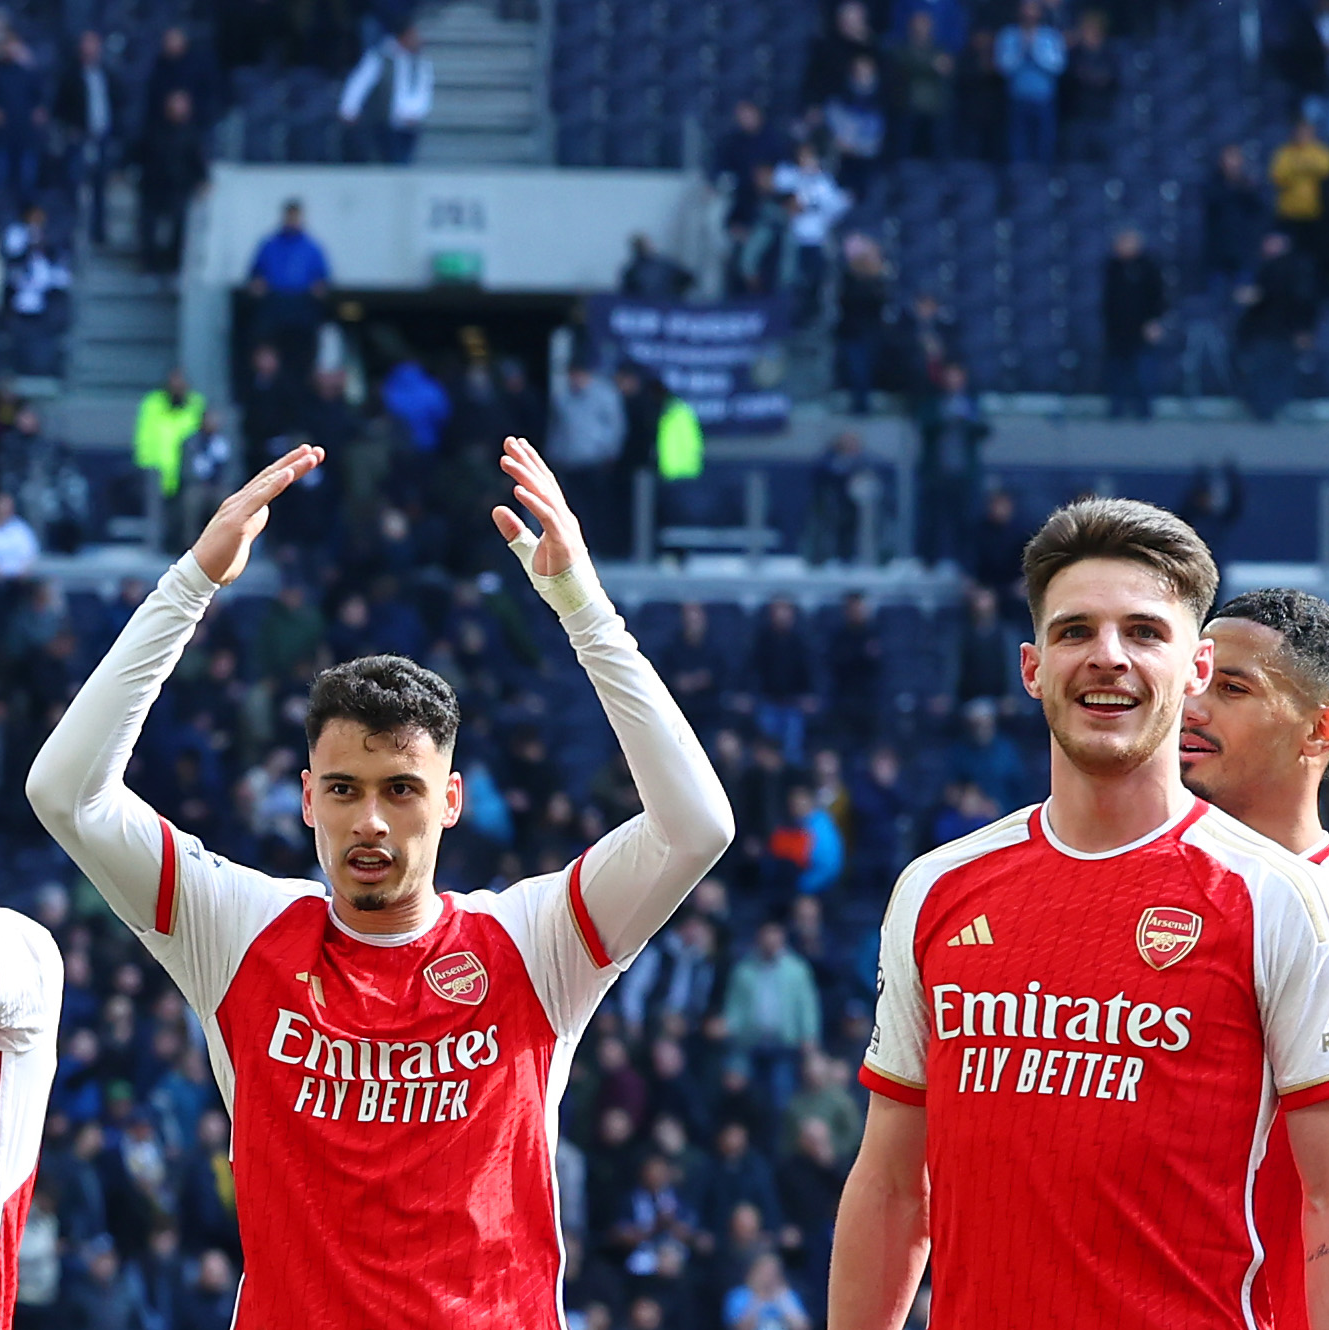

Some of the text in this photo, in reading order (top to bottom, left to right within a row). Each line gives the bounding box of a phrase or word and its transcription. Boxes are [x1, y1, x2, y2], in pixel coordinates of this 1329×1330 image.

[1148, 916, 1193, 932] Arsenal
[434, 960, 473, 981] Arsenal
[931, 980, 1192, 1052] Emirates
[268, 1007, 500, 1081] Emirates
[293, 1076, 470, 1124] FLY BETTER
[957, 1047, 1146, 1102] FLY BETTER
